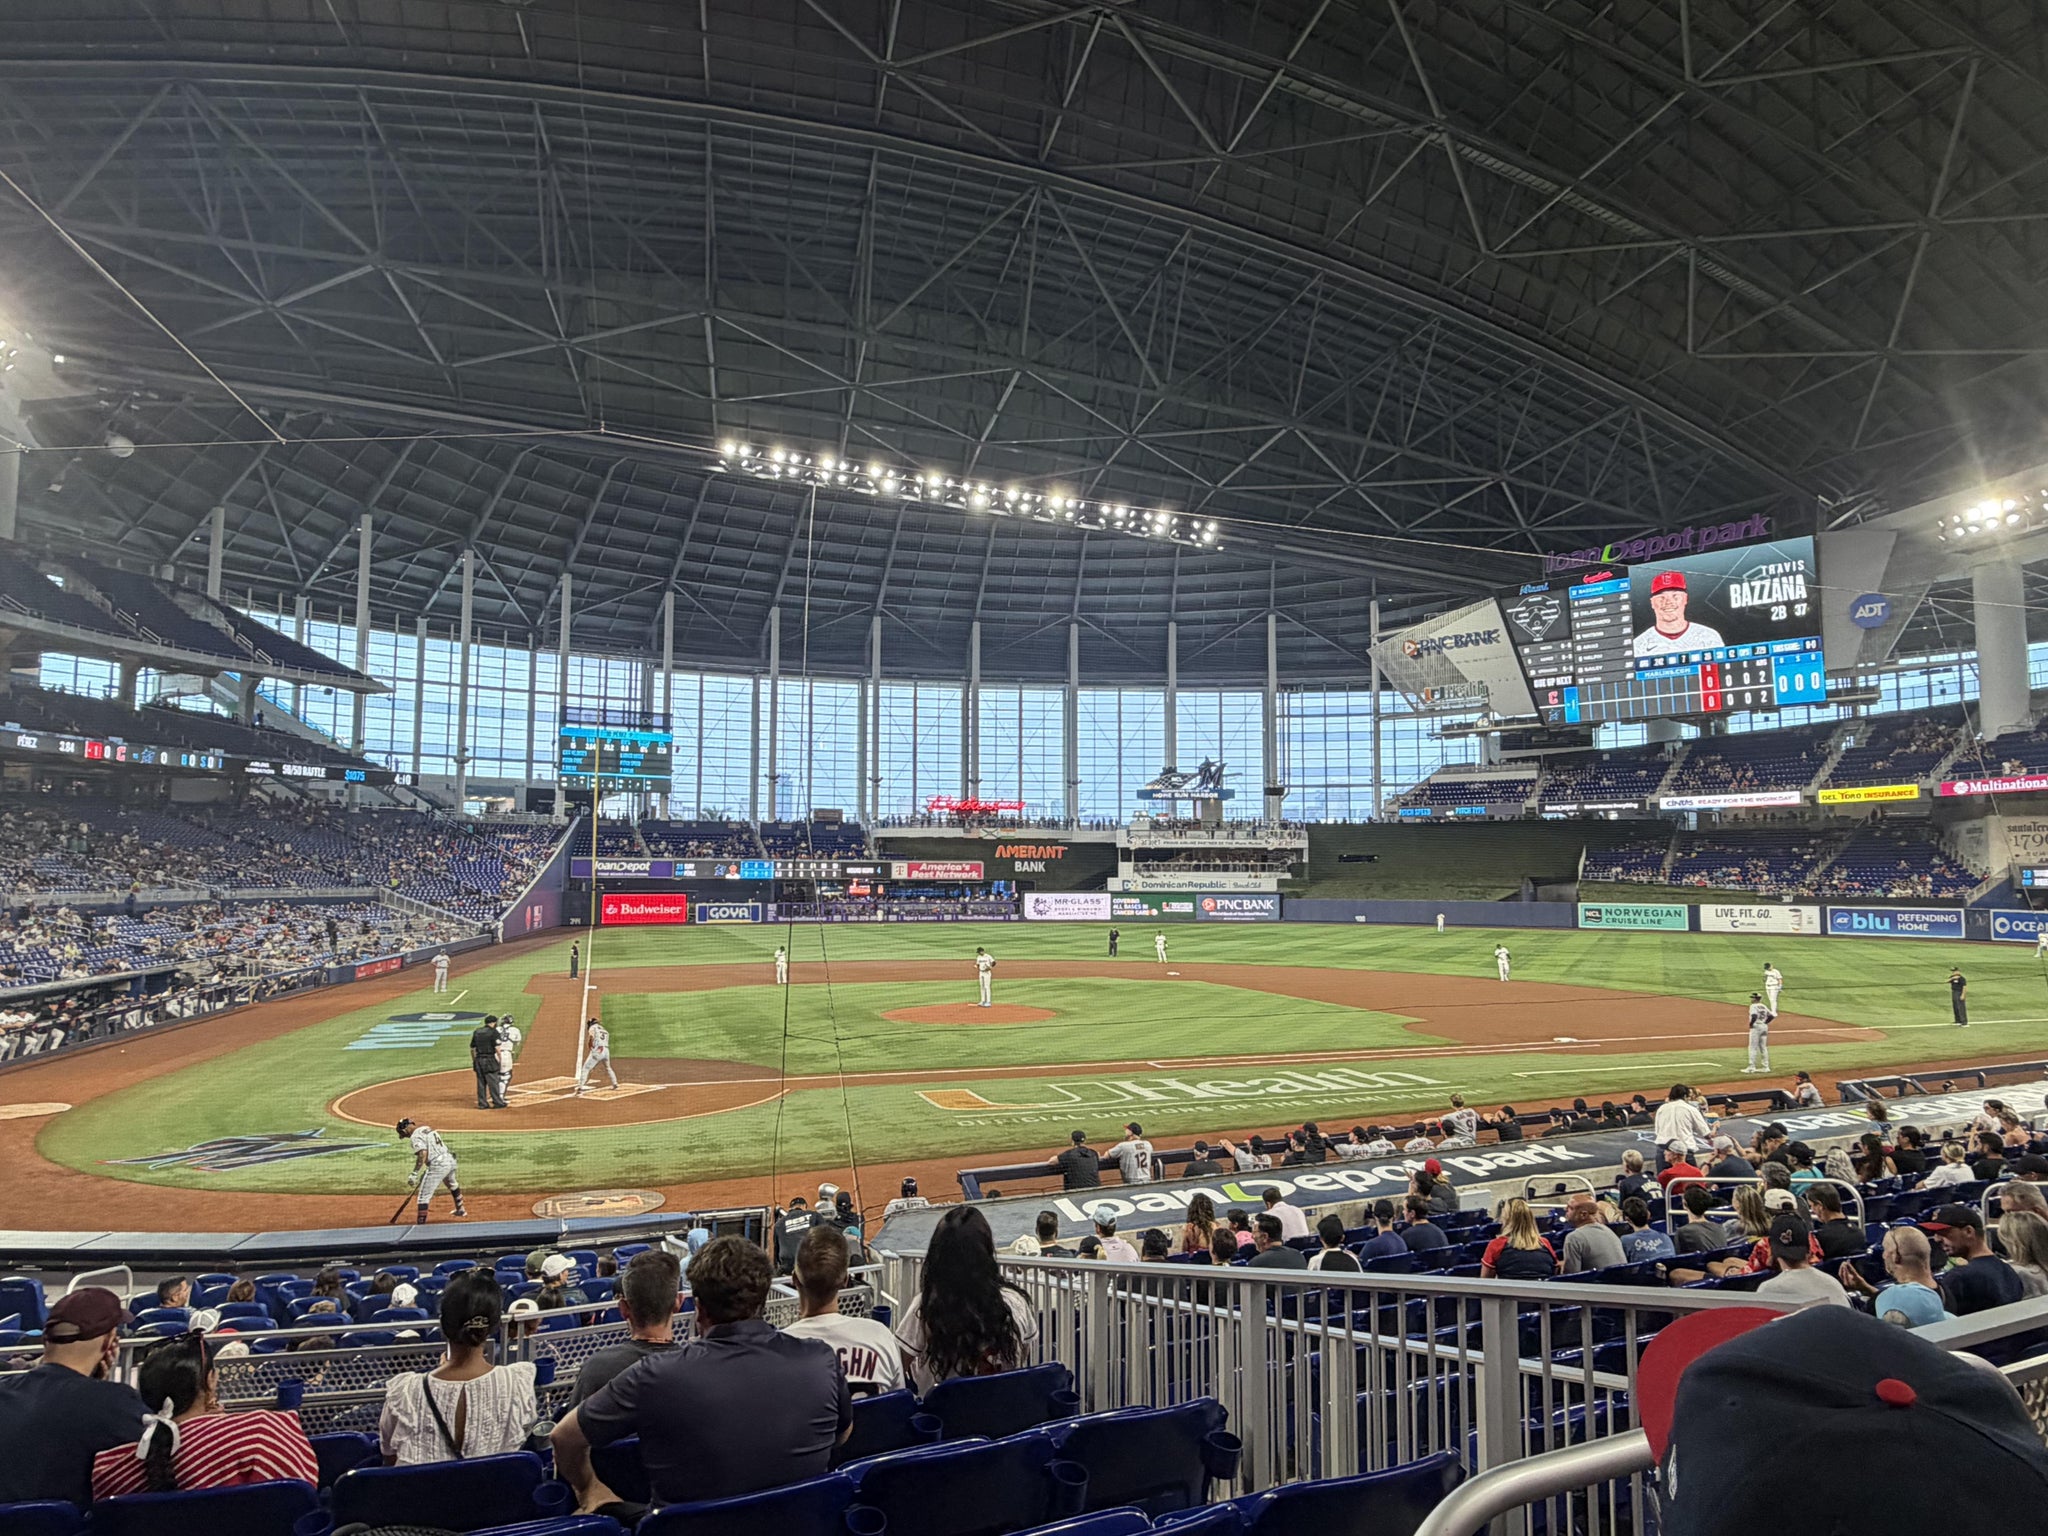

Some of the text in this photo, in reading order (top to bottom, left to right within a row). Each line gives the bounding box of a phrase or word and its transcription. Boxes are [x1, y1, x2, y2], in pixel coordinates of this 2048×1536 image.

[1546, 513, 1772, 573] loanDepot park
[1760, 560, 1806, 577] TRAVIS
[1729, 574, 1808, 608] BAZZANA
[1771, 603, 1808, 621] 2B 37
[1855, 603, 1886, 619] ADT
[1644, 668, 1691, 677] MARLINS.COM
[1707, 671, 1766, 688] 0 0 0 2
[1778, 672, 1820, 693] 0 0 0
[1708, 691, 1767, 707] 0 0 0 2
[17, 734, 38, 748] PÉREZ
[104, 745, 111, 759] 0
[160, 752, 168, 765] 0
[189, 754, 196, 767] 0
[200, 755, 207, 768] S
[207, 756, 214, 769] 0
[303, 766, 327, 778] RAFFLE
[393, 773, 412, 786] 4:10
[1969, 776, 2048, 792] Multinationa
[1840, 792, 1862, 800] TORO
[1864, 790, 1915, 799] INSURANCE
[995, 845, 1067, 859] AMERANT
[595, 861, 650, 872] loanDepot
[877, 866, 882, 874] 4
[919, 863, 970, 871] America's
[1014, 861, 1046, 872] BANK
[911, 871, 979, 879] Best Network
[1142, 881, 1187, 889] Dominican
[1187, 880, 1226, 889] Republic
[620, 903, 682, 915] Budweiser
[709, 906, 749, 921] GOYA
[1605, 908, 1682, 918] NORWEGIAN
[1715, 908, 1772, 918] LIVE. FIT. GO.
[1605, 917, 1639, 925] CRUISE
[1852, 912, 1890, 930] blu
[1897, 913, 1958, 923] DEFENDING
[1898, 923, 1930, 932] HOME
[955, 1095, 1390, 1128] OFFICIAL DOCTORS OF THE MIAMI
[1465, 1119, 1474, 1133] 9
[1134, 1152, 1148, 1169] 12
[1443, 1143, 1595, 1177] park
[785, 1214, 812, 1226] BEST
